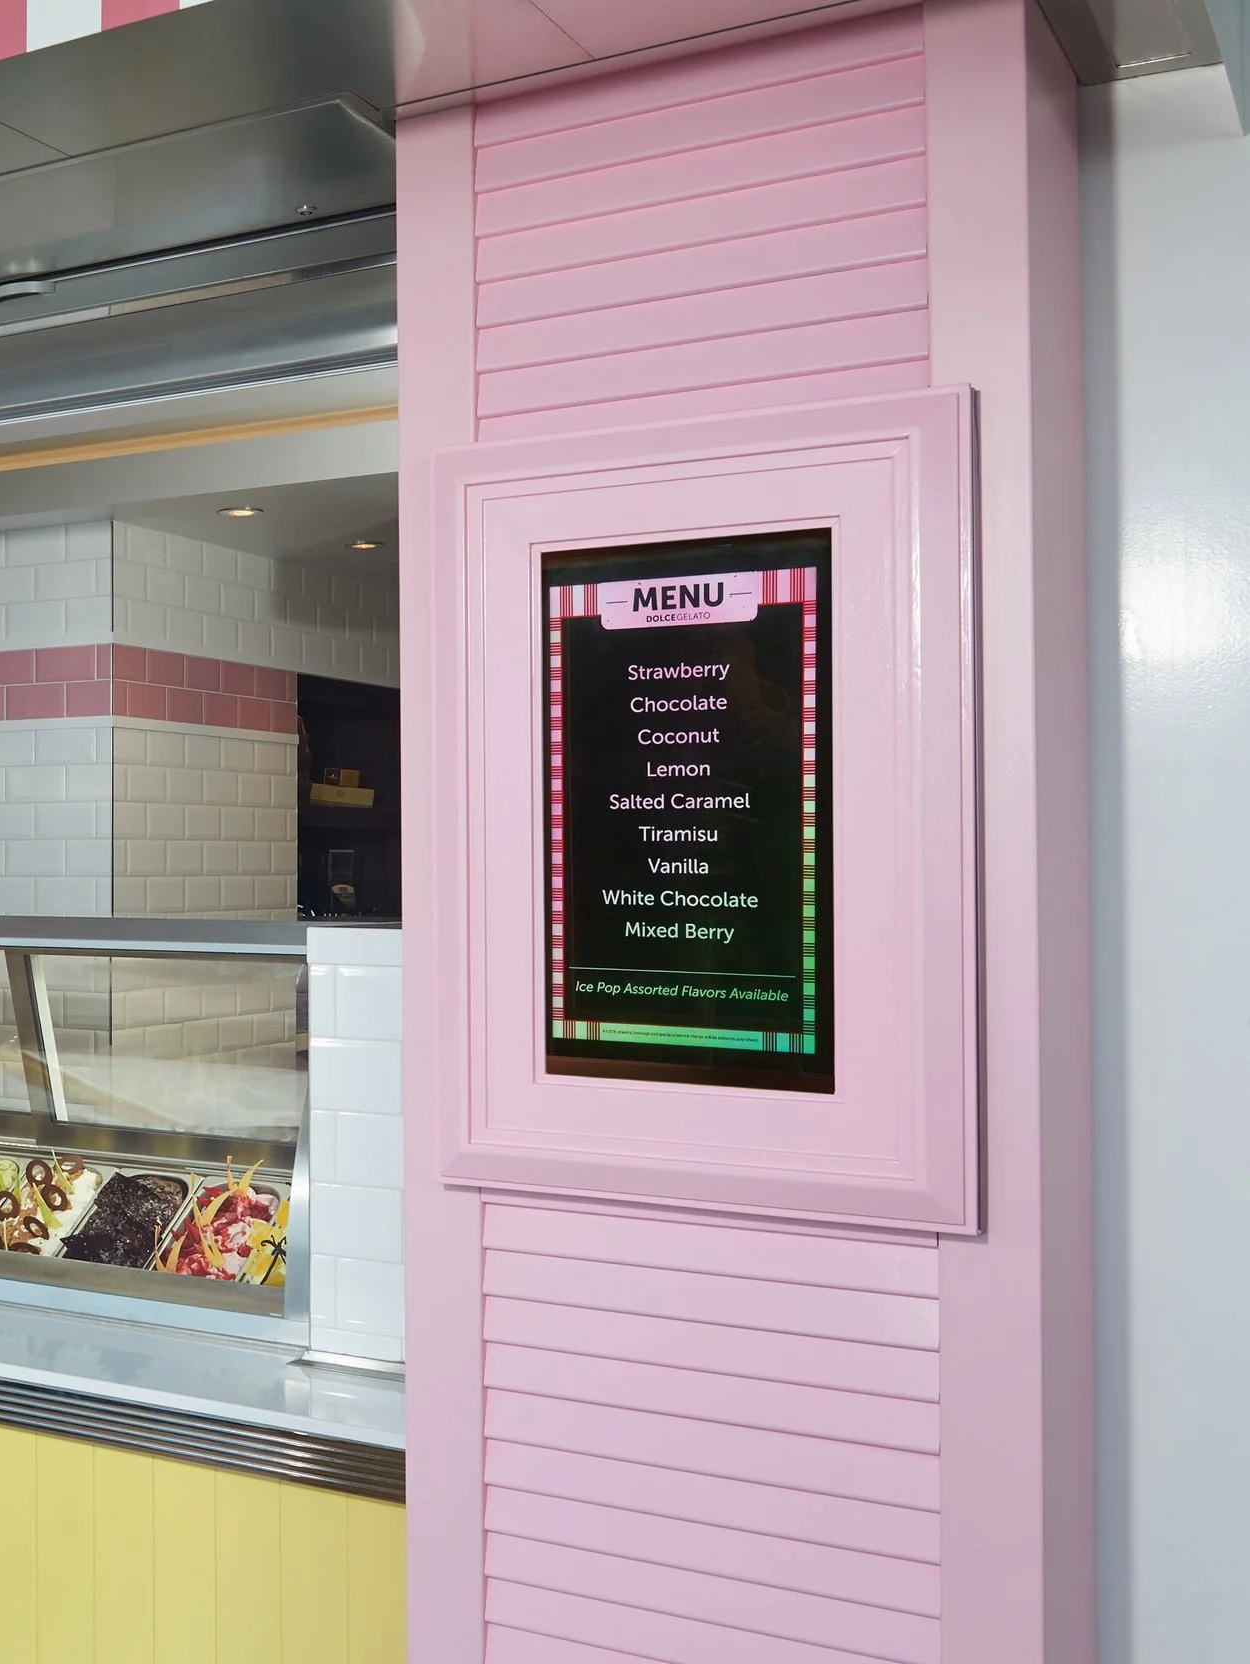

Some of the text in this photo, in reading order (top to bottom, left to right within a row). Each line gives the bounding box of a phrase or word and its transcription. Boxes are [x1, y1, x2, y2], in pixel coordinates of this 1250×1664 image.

[632, 581, 724, 612] MENU
[627, 662, 731, 681] Strawberry
[630, 694, 728, 713] Chocolate
[637, 728, 720, 745] Coconut
[647, 761, 711, 778] Lemon
[609, 792, 751, 810] Salted Caramel
[638, 825, 718, 842] Tiramisu
[647, 857, 709, 875] Vanilla
[601, 889, 759, 909] White Chocolate
[625, 921, 735, 944] Mixed Berry
[575, 980, 789, 1002] Ice Pop Assorted Flavors Available
